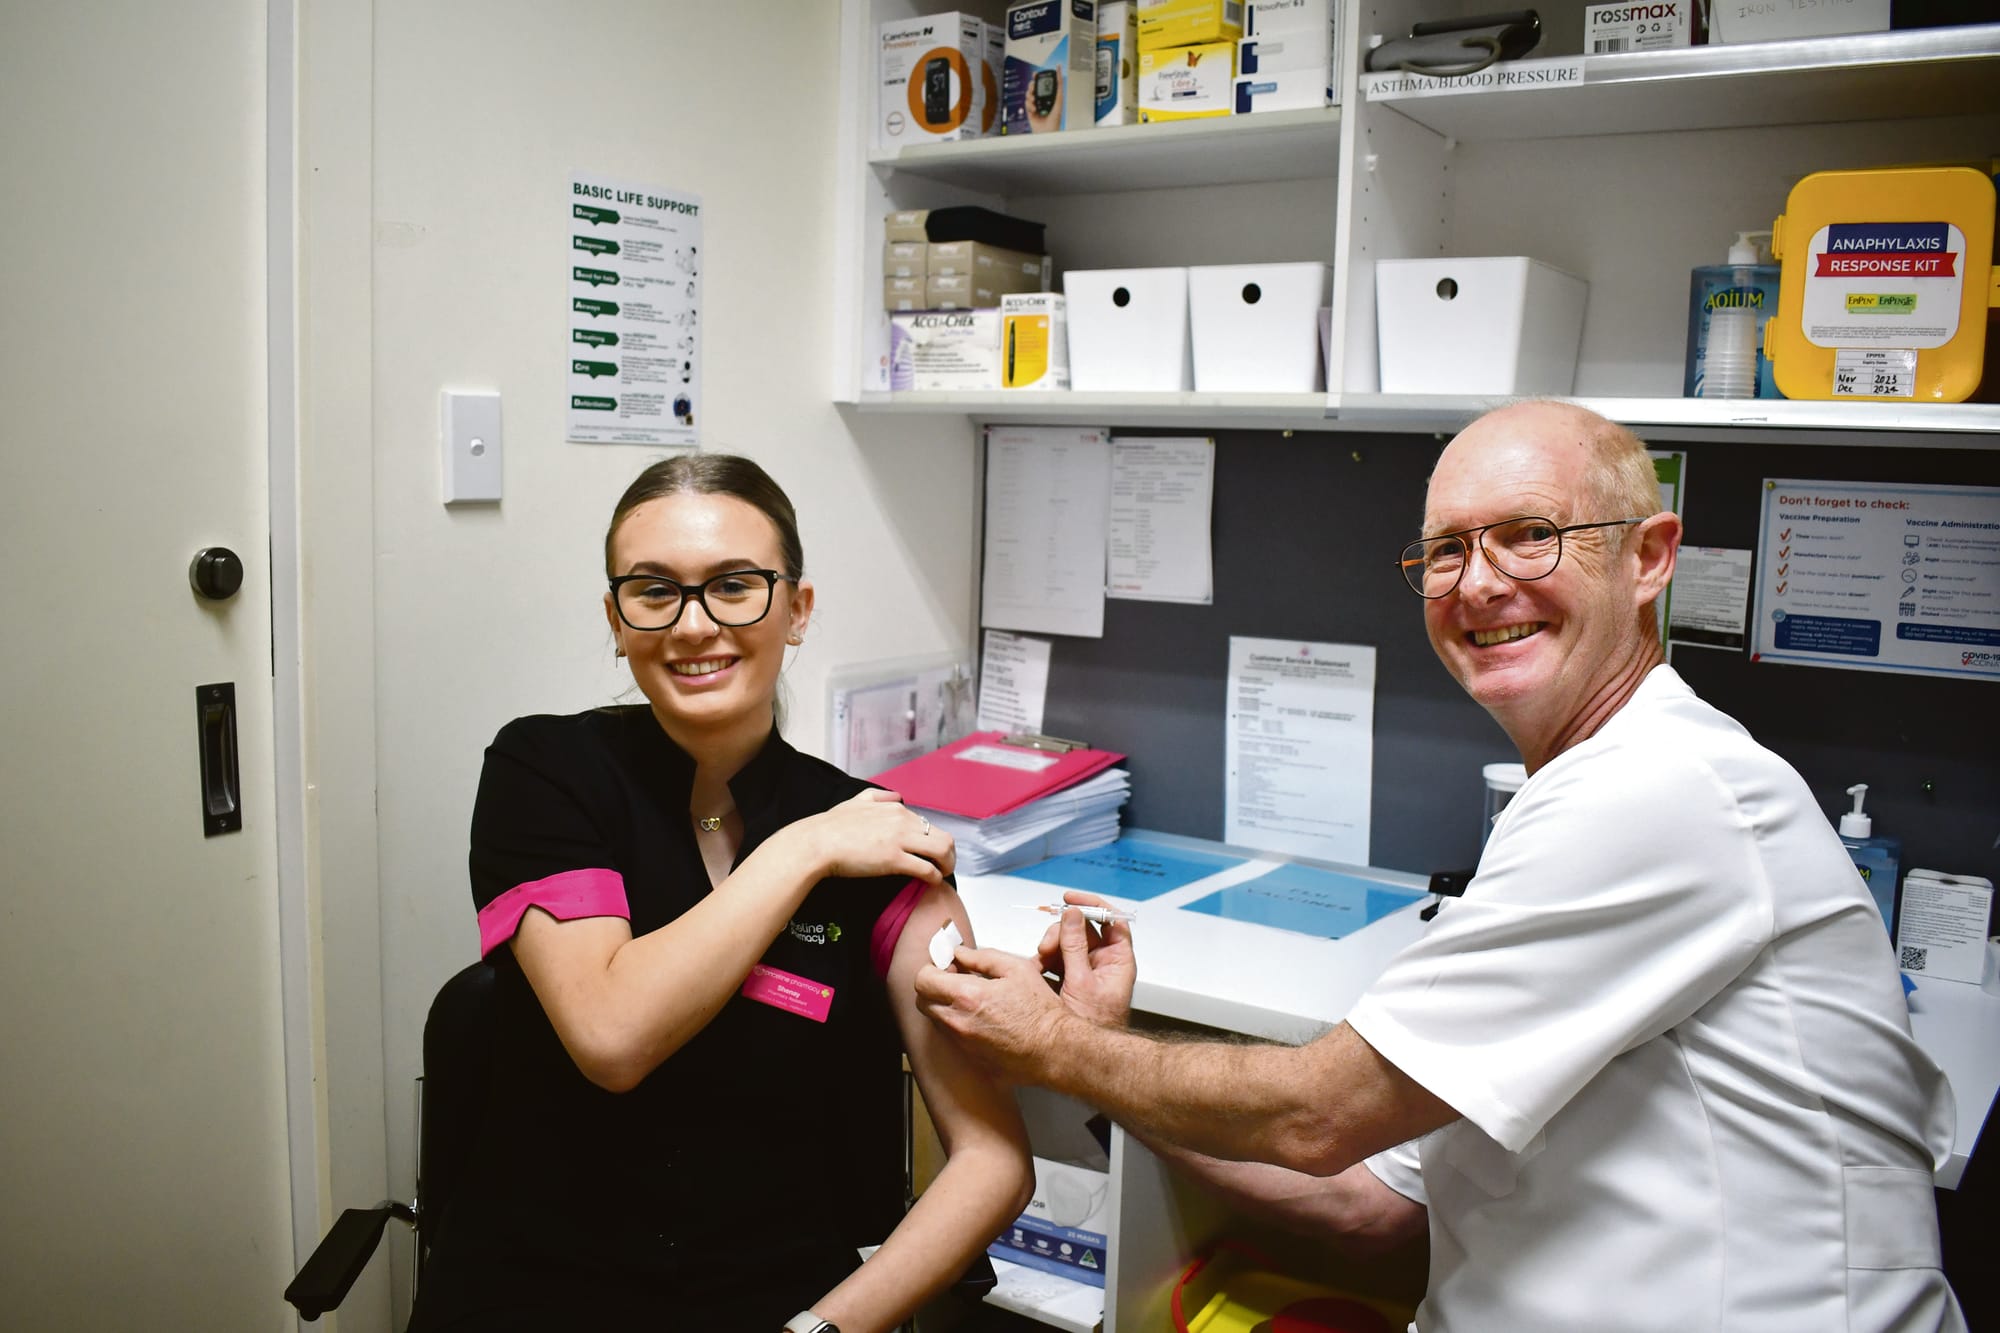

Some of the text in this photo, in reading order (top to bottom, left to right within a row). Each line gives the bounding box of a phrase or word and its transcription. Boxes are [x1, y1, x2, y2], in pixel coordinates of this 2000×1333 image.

[1014, 6, 1048, 22] Contour
[1594, 3, 1676, 25] rossmax
[1370, 67, 1579, 94] ASTHMA/BLOOD PRESSURE
[573, 182, 698, 217] BASIC LIFE SUPPORT
[1832, 238, 1940, 250] ANAPHYLAXIS
[1830, 259, 1940, 272] RESPONSE KIT
[911, 314, 974, 328] ACCU-CHEK
[1838, 374, 1898, 384] Nov 2023
[1838, 384, 1898, 394] Dec 2024
[1779, 495, 1910, 510] Don't forget to check:
[1779, 513, 1861, 524] Vaccine Preparation
[1905, 519, 2000, 530] Vaccine Administratio
[1962, 652, 2000, 660] COVID-19
